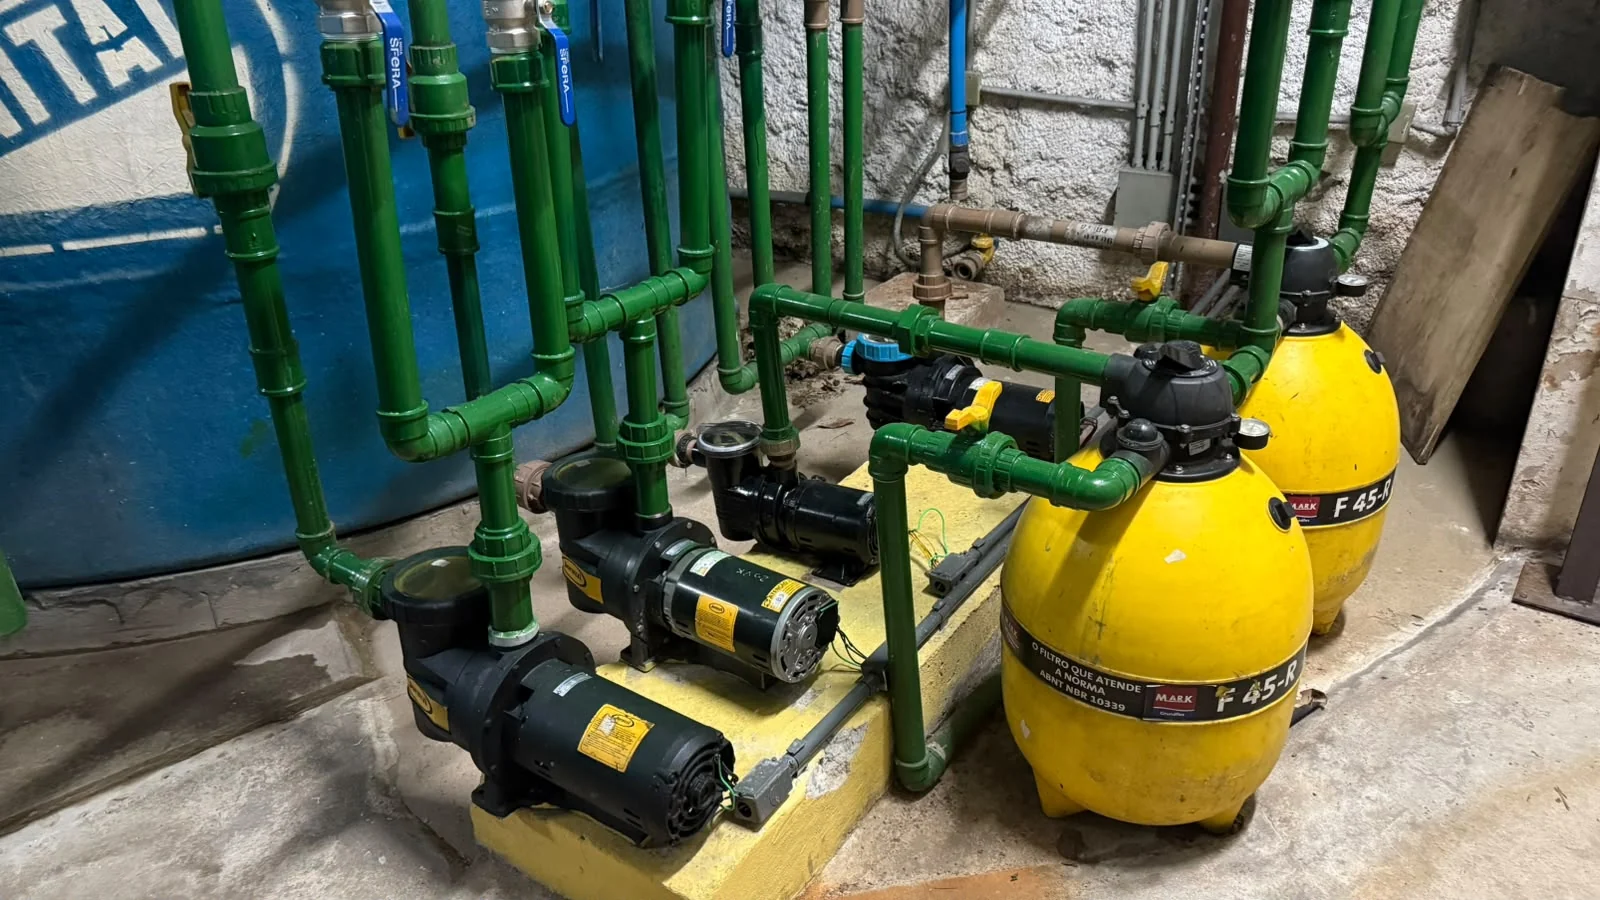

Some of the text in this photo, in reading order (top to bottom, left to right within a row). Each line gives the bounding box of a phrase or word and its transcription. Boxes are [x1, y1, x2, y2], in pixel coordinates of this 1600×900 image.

[1333, 478, 1392, 518] F 45-R
[1031, 641, 1142, 694] O FILTRO QUE ATENDE
[1055, 668, 1107, 697] A NORMA
[1216, 659, 1298, 713] F 45-R
[1039, 669, 1127, 713] ABNT NBR 10339
[1155, 693, 1193, 704] MARK
